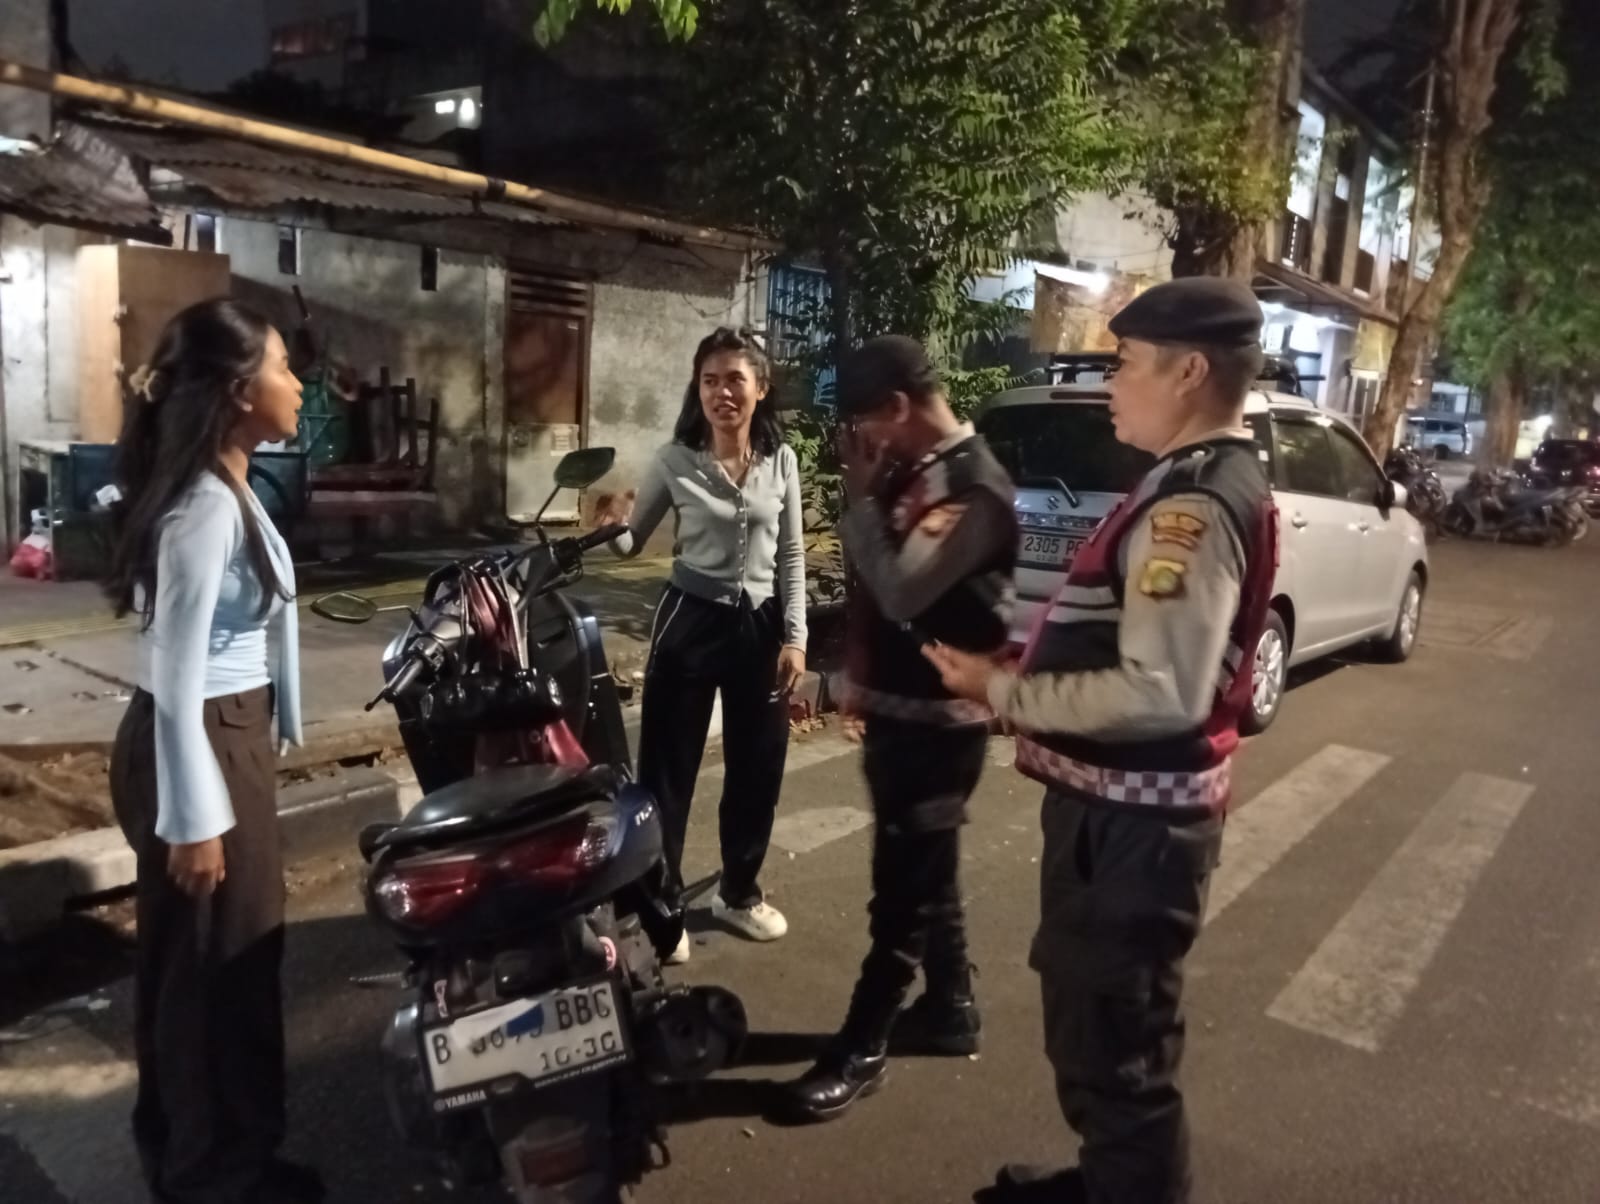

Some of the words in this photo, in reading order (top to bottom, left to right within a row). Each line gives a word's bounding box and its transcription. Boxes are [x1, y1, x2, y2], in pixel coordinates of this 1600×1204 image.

[1024, 536, 1060, 554] 2305
[432, 1033, 451, 1065] B
[555, 989, 611, 1031] BBC
[445, 1089, 487, 1109] YAMAHA
